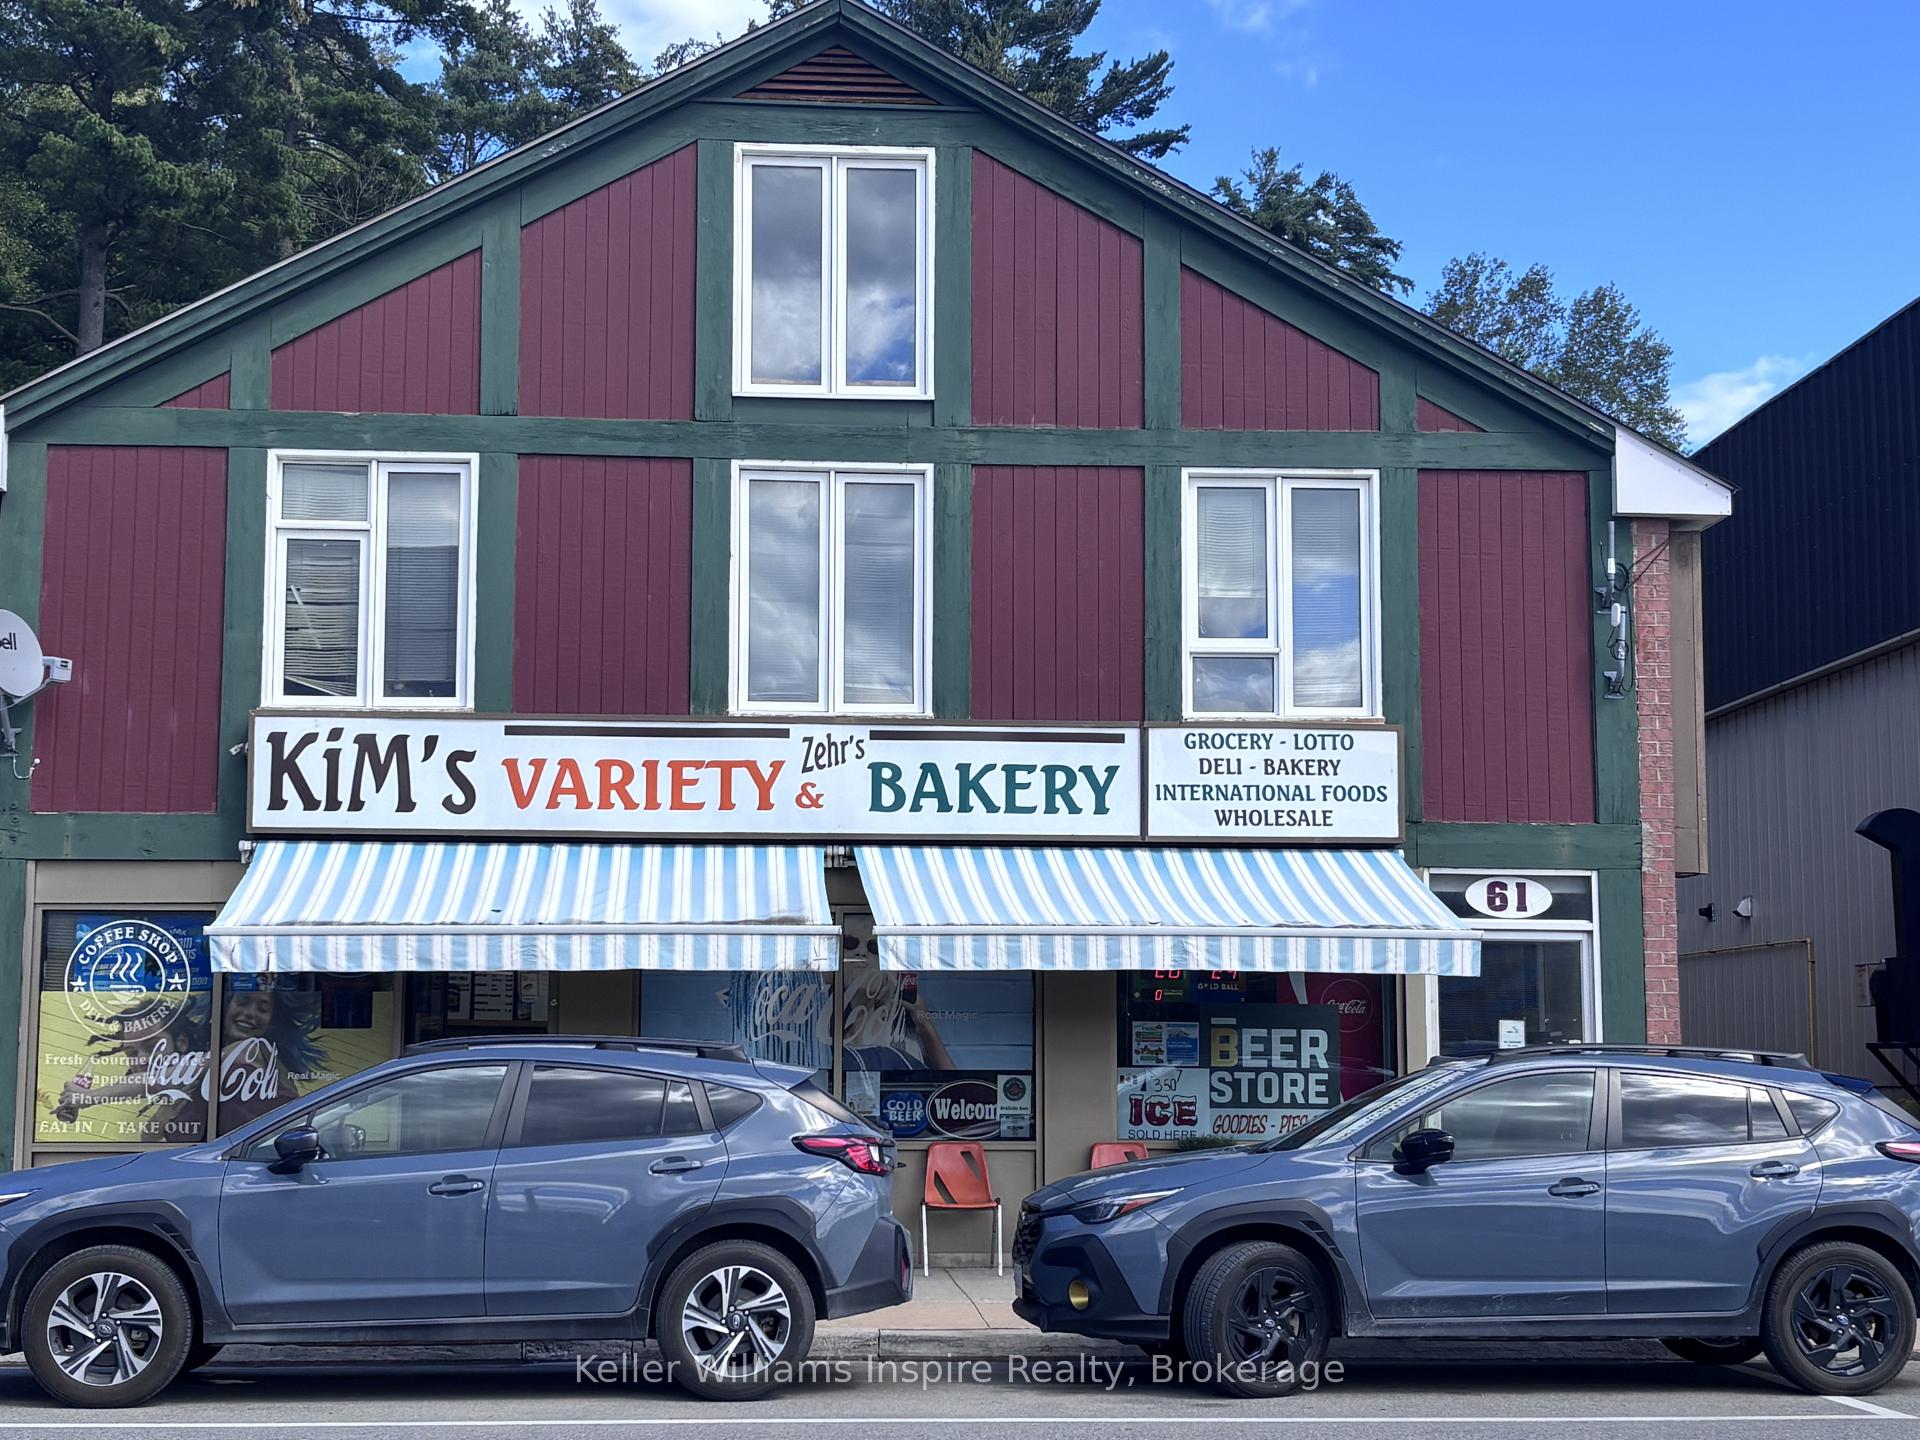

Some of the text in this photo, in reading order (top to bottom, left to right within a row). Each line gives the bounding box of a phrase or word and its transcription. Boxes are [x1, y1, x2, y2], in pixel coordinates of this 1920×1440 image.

[1184, 733, 1274, 750] GROCERY
[1293, 733, 1354, 751] LOTTO
[801, 733, 866, 774] Zehr's
[266, 727, 1120, 815] KiM's VARIETY & BAKERY
[1199, 758, 1242, 775] DELI
[1263, 758, 1341, 776] BAKERY
[1155, 784, 1388, 802] INTERNATIONAL FOODS
[1214, 809, 1334, 827] WHOLESALE
[1486, 880, 1528, 912] 61
[79, 926, 178, 965] COFFEE SHOP
[80, 999, 108, 1028] DELI
[123, 998, 178, 1033] BAKERY
[1210, 1027, 1329, 1069] BEER
[45, 1053, 82, 1065] Fresh
[287, 1071, 309, 1080] Real
[1210, 1070, 1329, 1104] STORE
[71, 1092, 141, 1105] Flavoured
[886, 1099, 924, 1111] COLD
[888, 1110, 922, 1122] BEER
[934, 1098, 998, 1121] Welcom
[1128, 1093, 1198, 1127] ICE
[39, 1121, 201, 1134] EAT IN / TAKE OUT
[1212, 1114, 1268, 1134] GOODIES
[1128, 1129, 1160, 1140] SOLD
